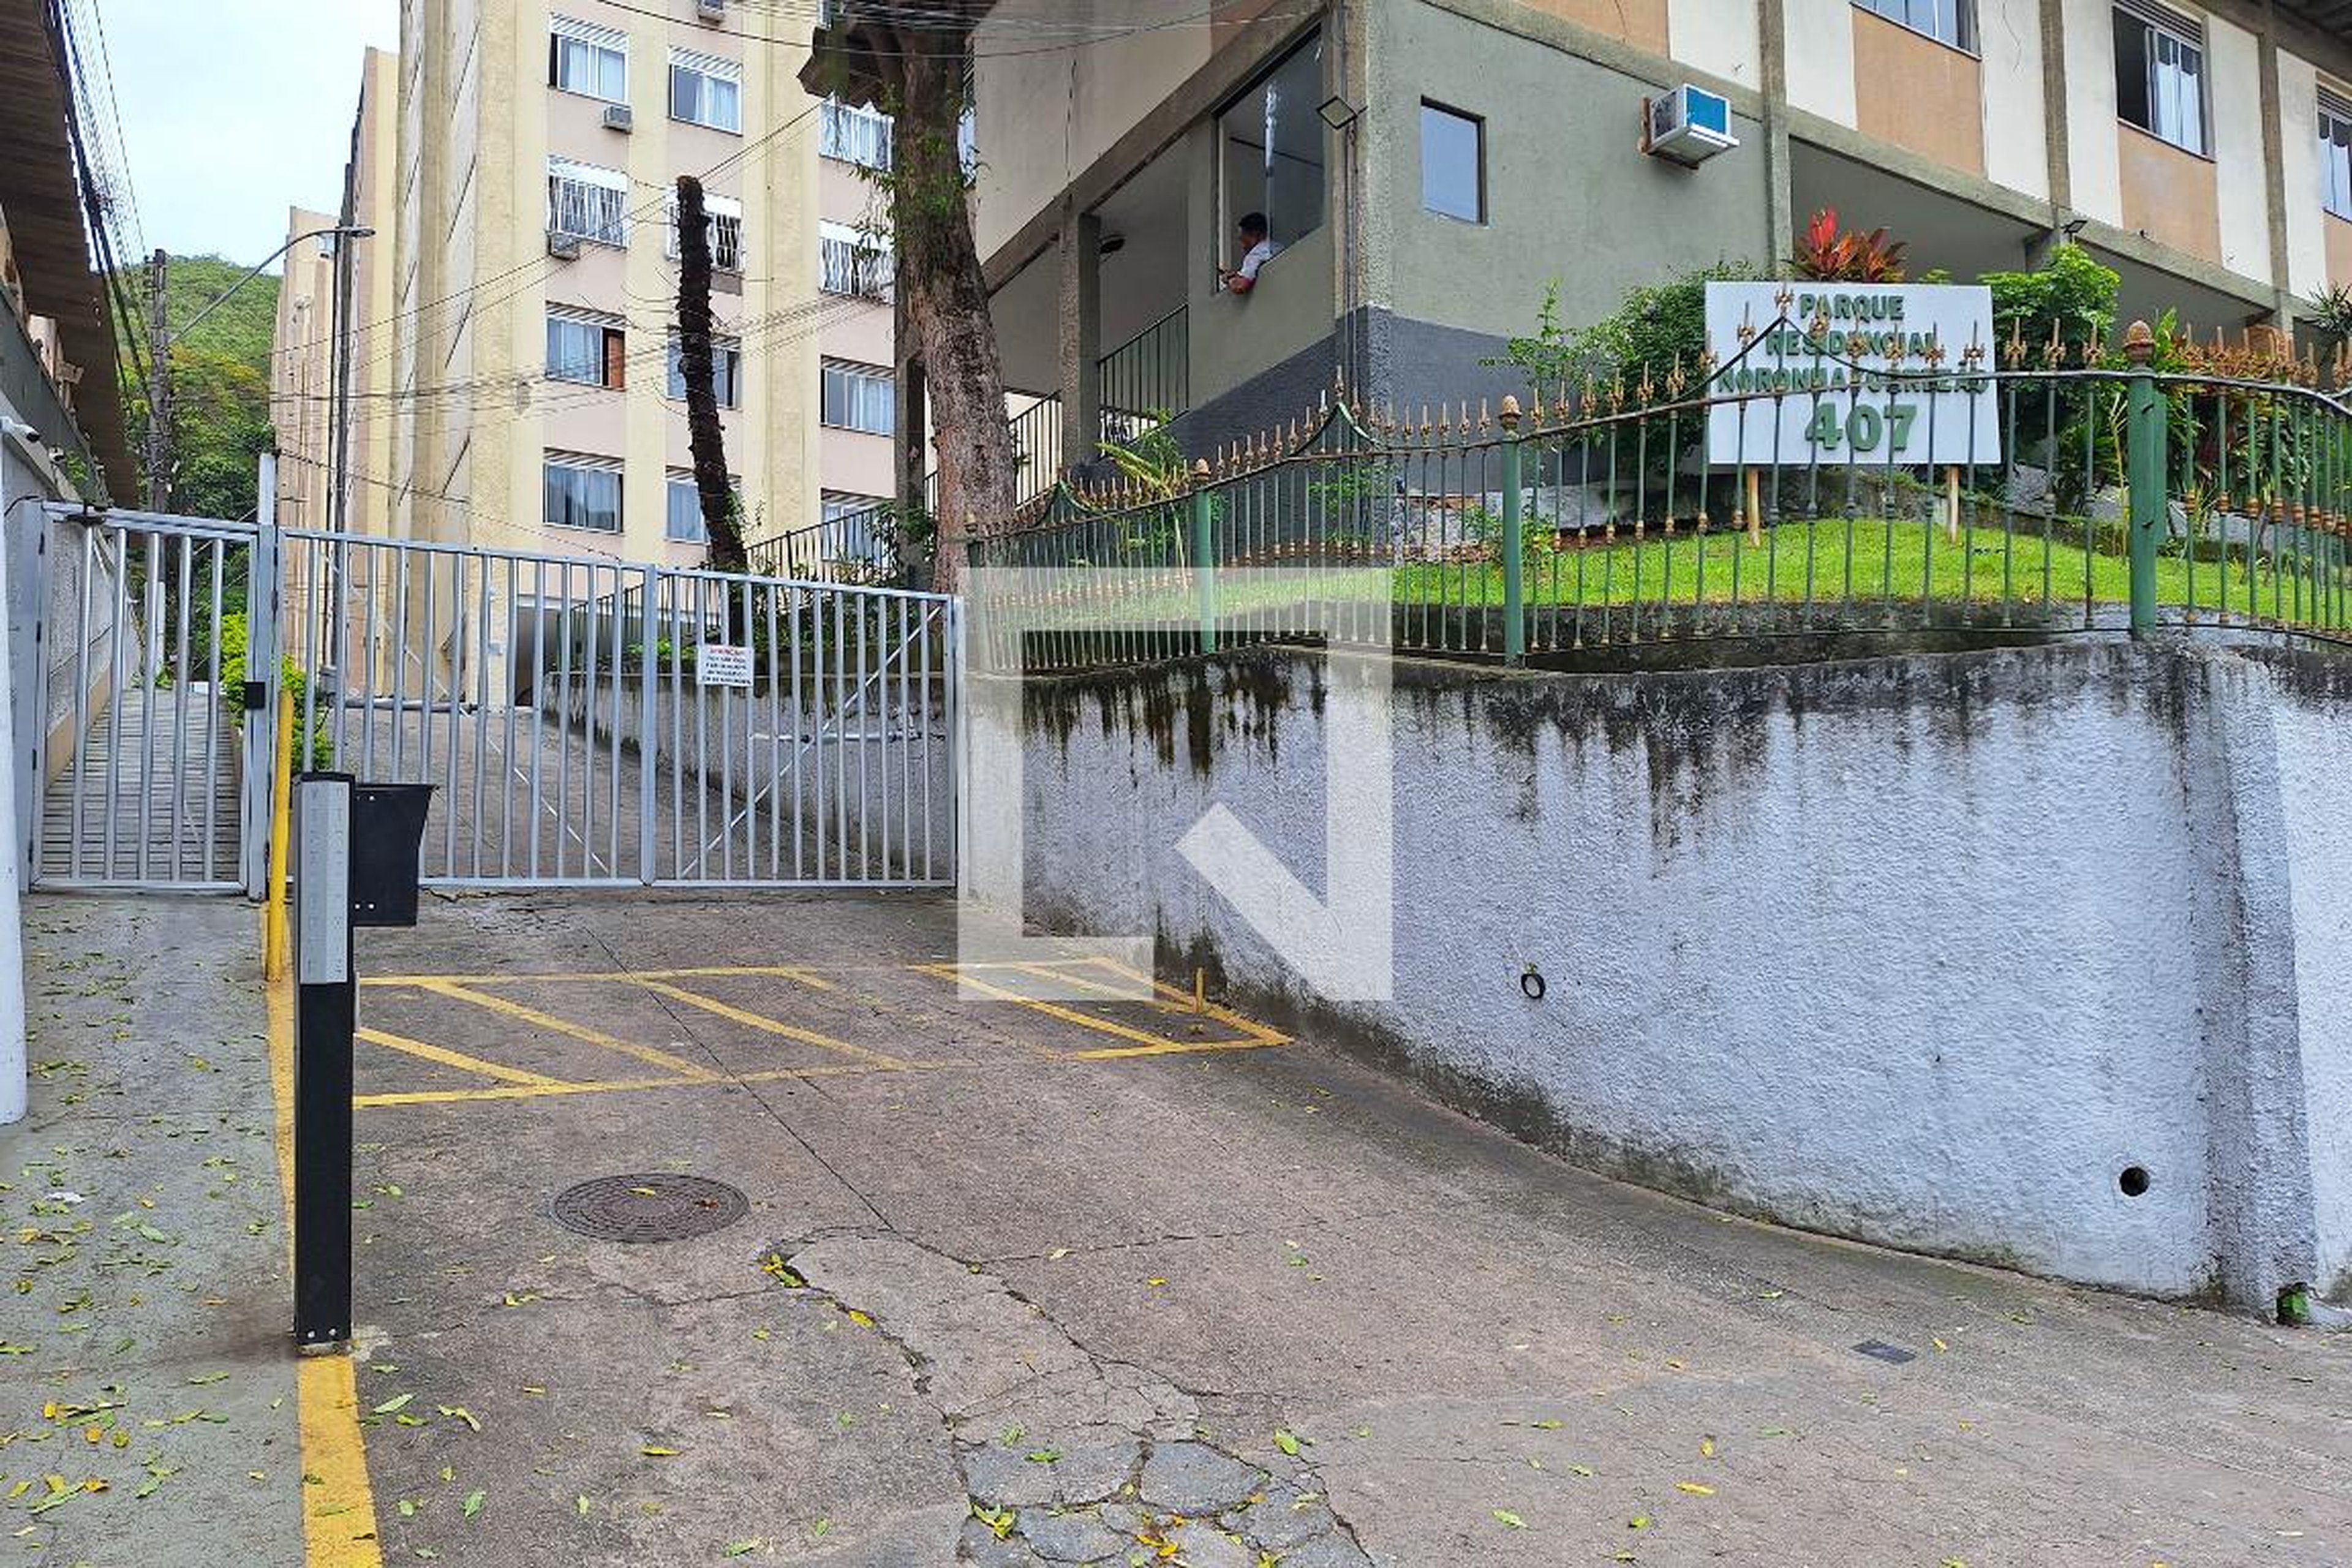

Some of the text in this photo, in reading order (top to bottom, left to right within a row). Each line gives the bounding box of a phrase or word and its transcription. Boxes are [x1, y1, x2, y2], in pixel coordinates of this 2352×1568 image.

[1799, 293, 1904, 323] PARQUE
[1766, 330, 1938, 356] RESDNCIAL
[1805, 402, 1917, 451] 407
